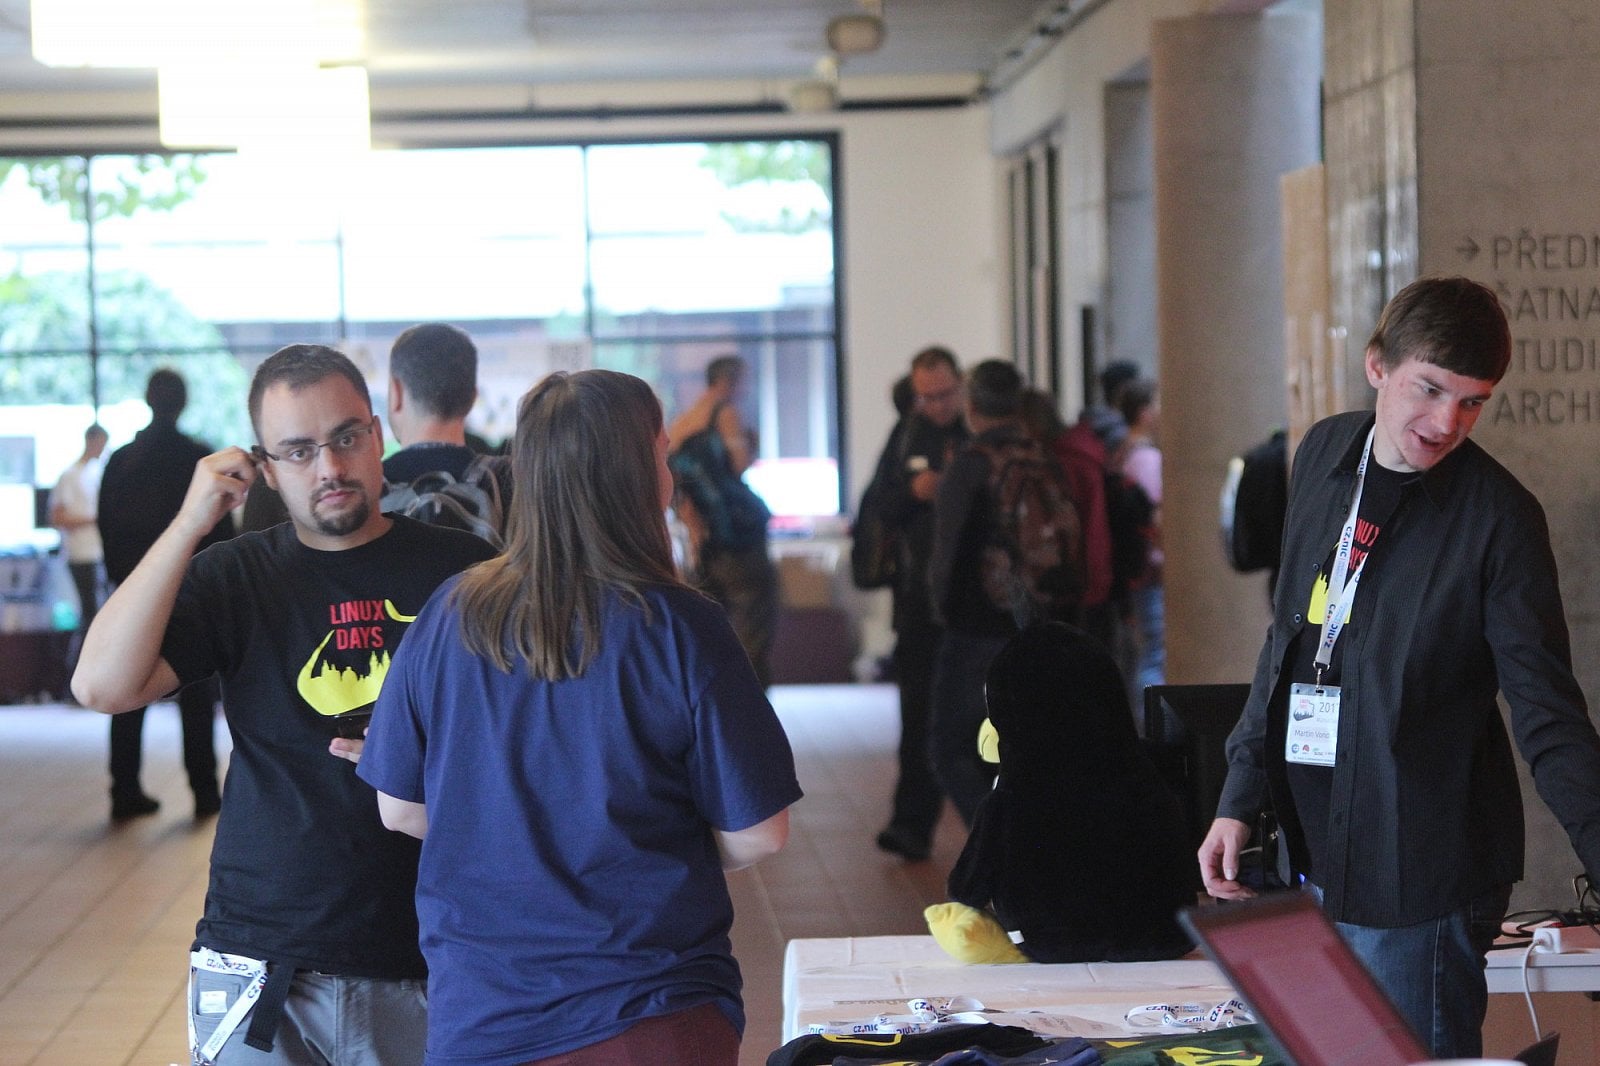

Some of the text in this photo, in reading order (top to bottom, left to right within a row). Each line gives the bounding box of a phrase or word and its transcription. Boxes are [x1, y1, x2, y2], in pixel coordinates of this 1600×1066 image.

[1507, 337, 1596, 374] TUDI
[329, 600, 385, 625] LINUX
[335, 626, 384, 650] DAYS
